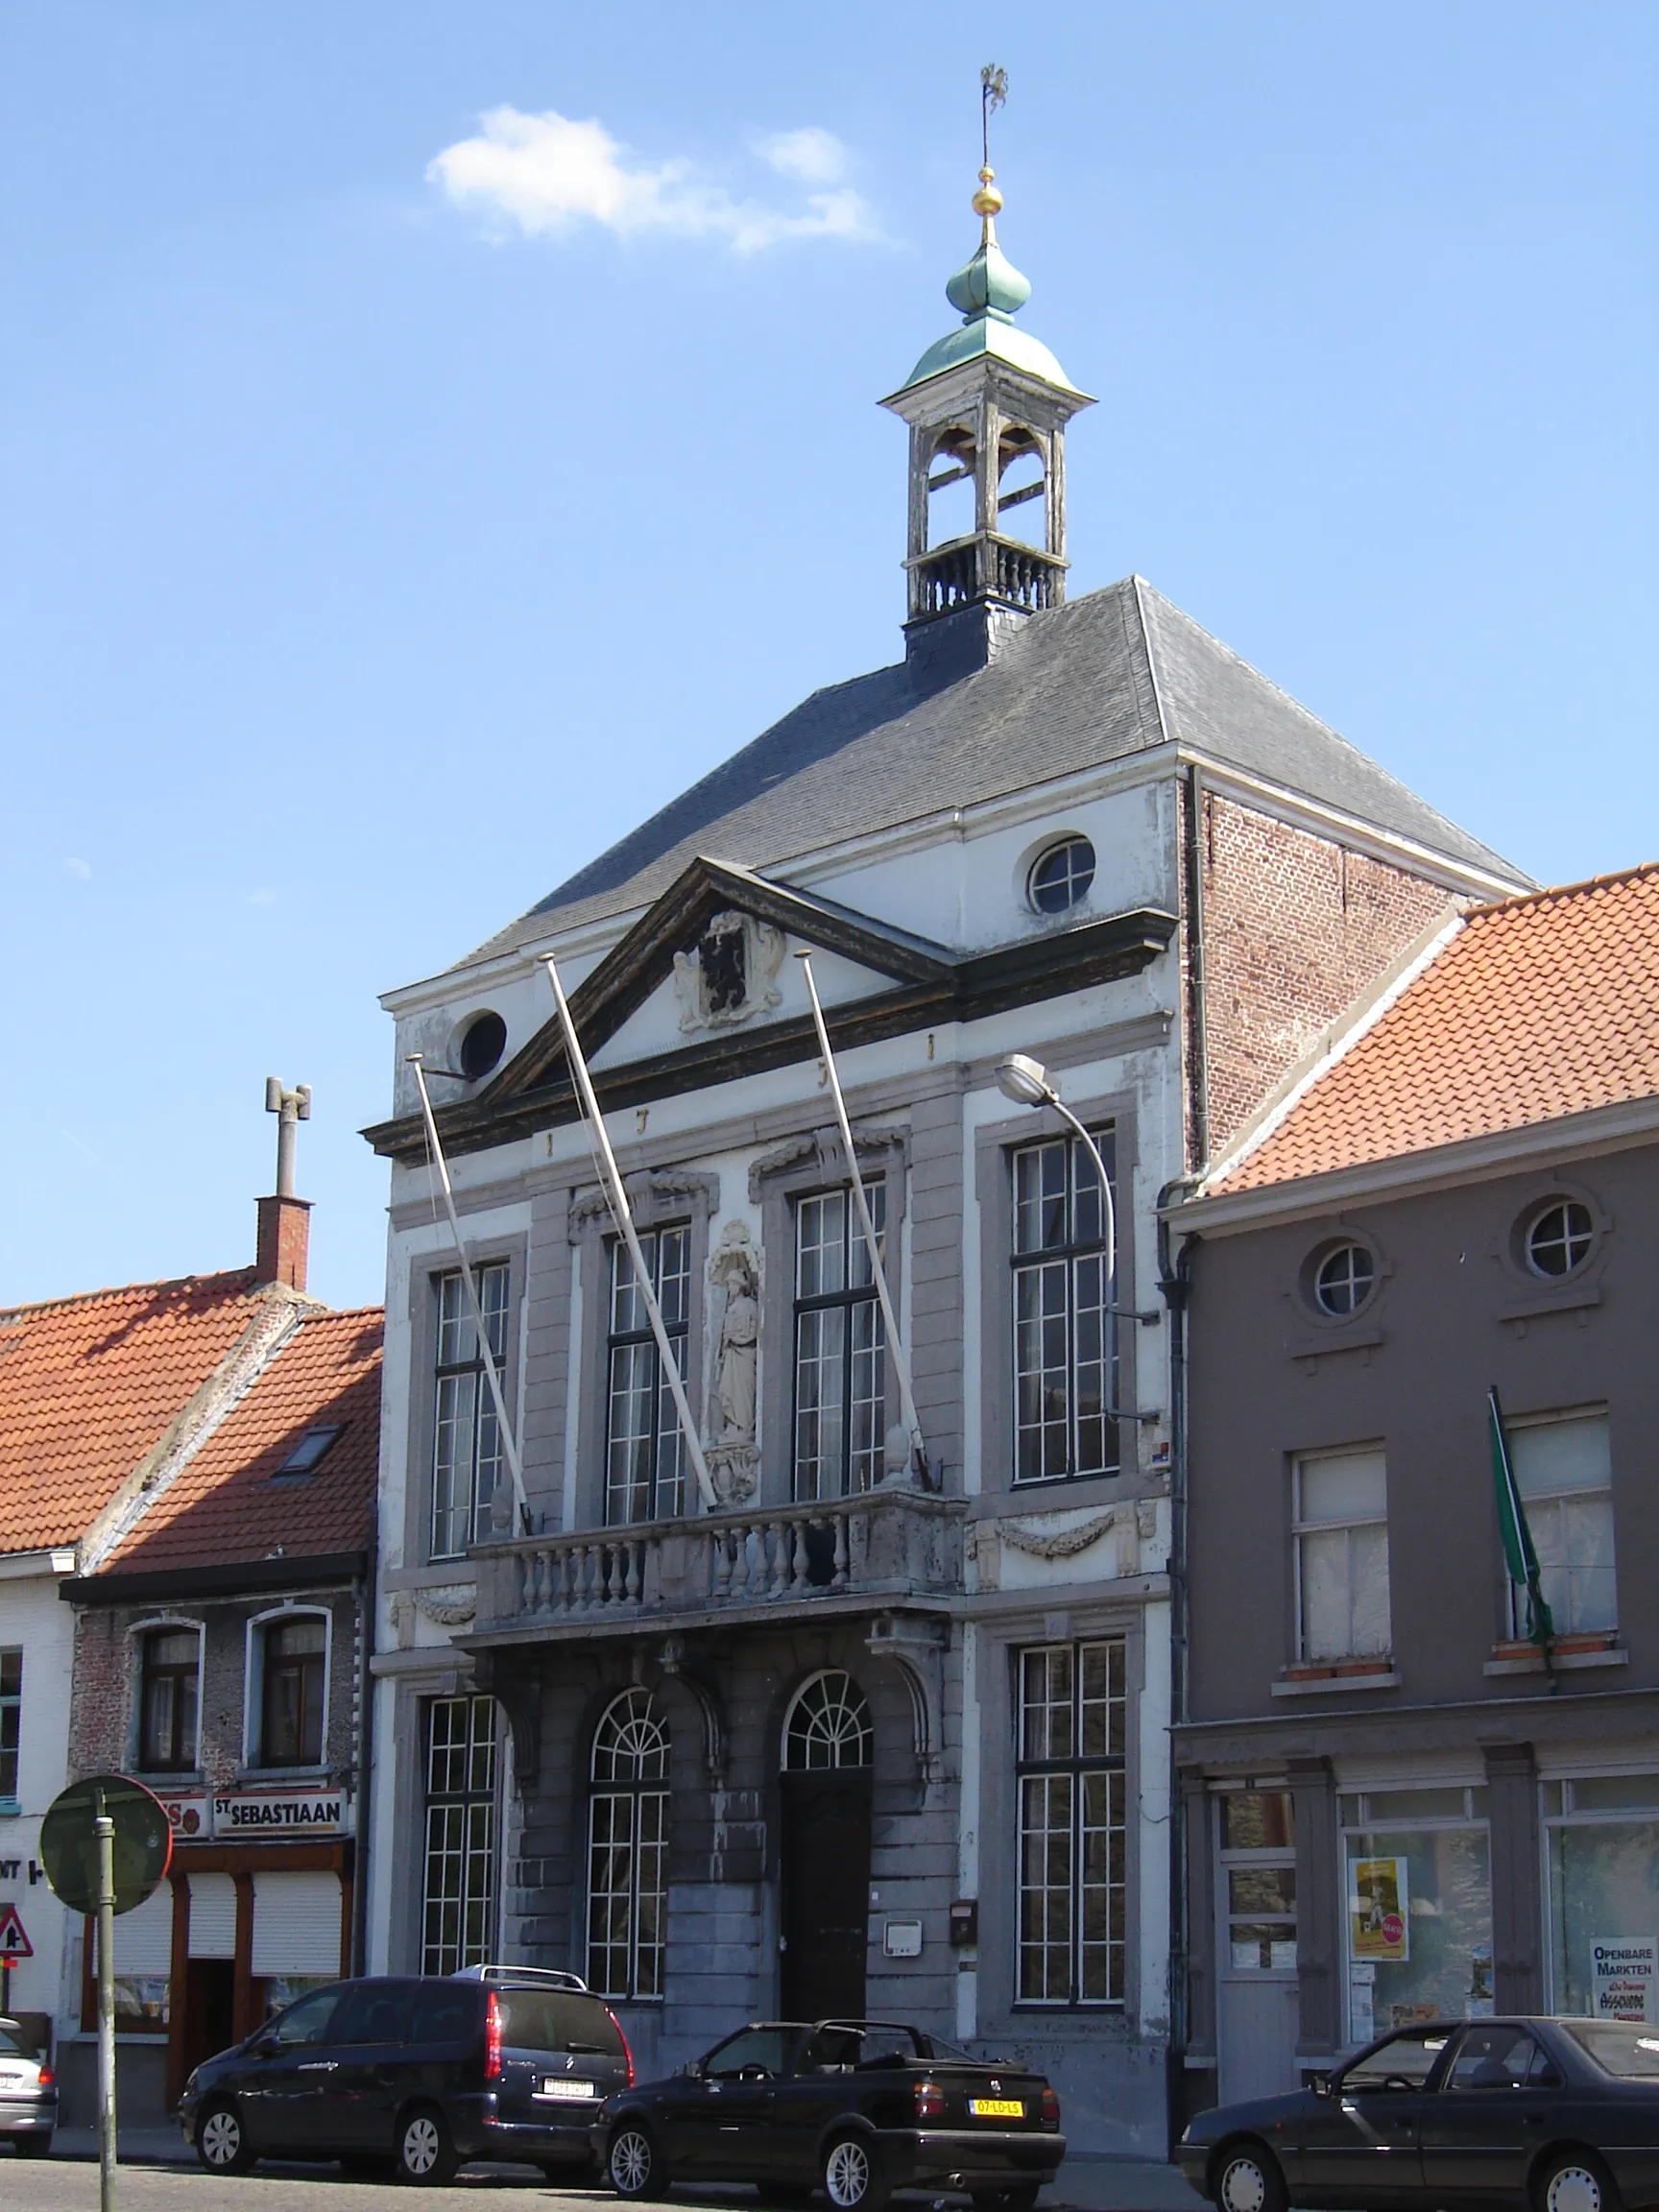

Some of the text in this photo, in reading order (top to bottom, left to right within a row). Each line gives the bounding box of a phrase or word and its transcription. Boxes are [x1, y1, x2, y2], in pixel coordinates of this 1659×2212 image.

[231, 1802, 341, 1825] SEBASTIAAN
[1594, 1946, 1653, 1960] OPENBARE
[1598, 1961, 1652, 1976] MARKTEN
[977, 2101, 1019, 2114] 07-LD-LS
